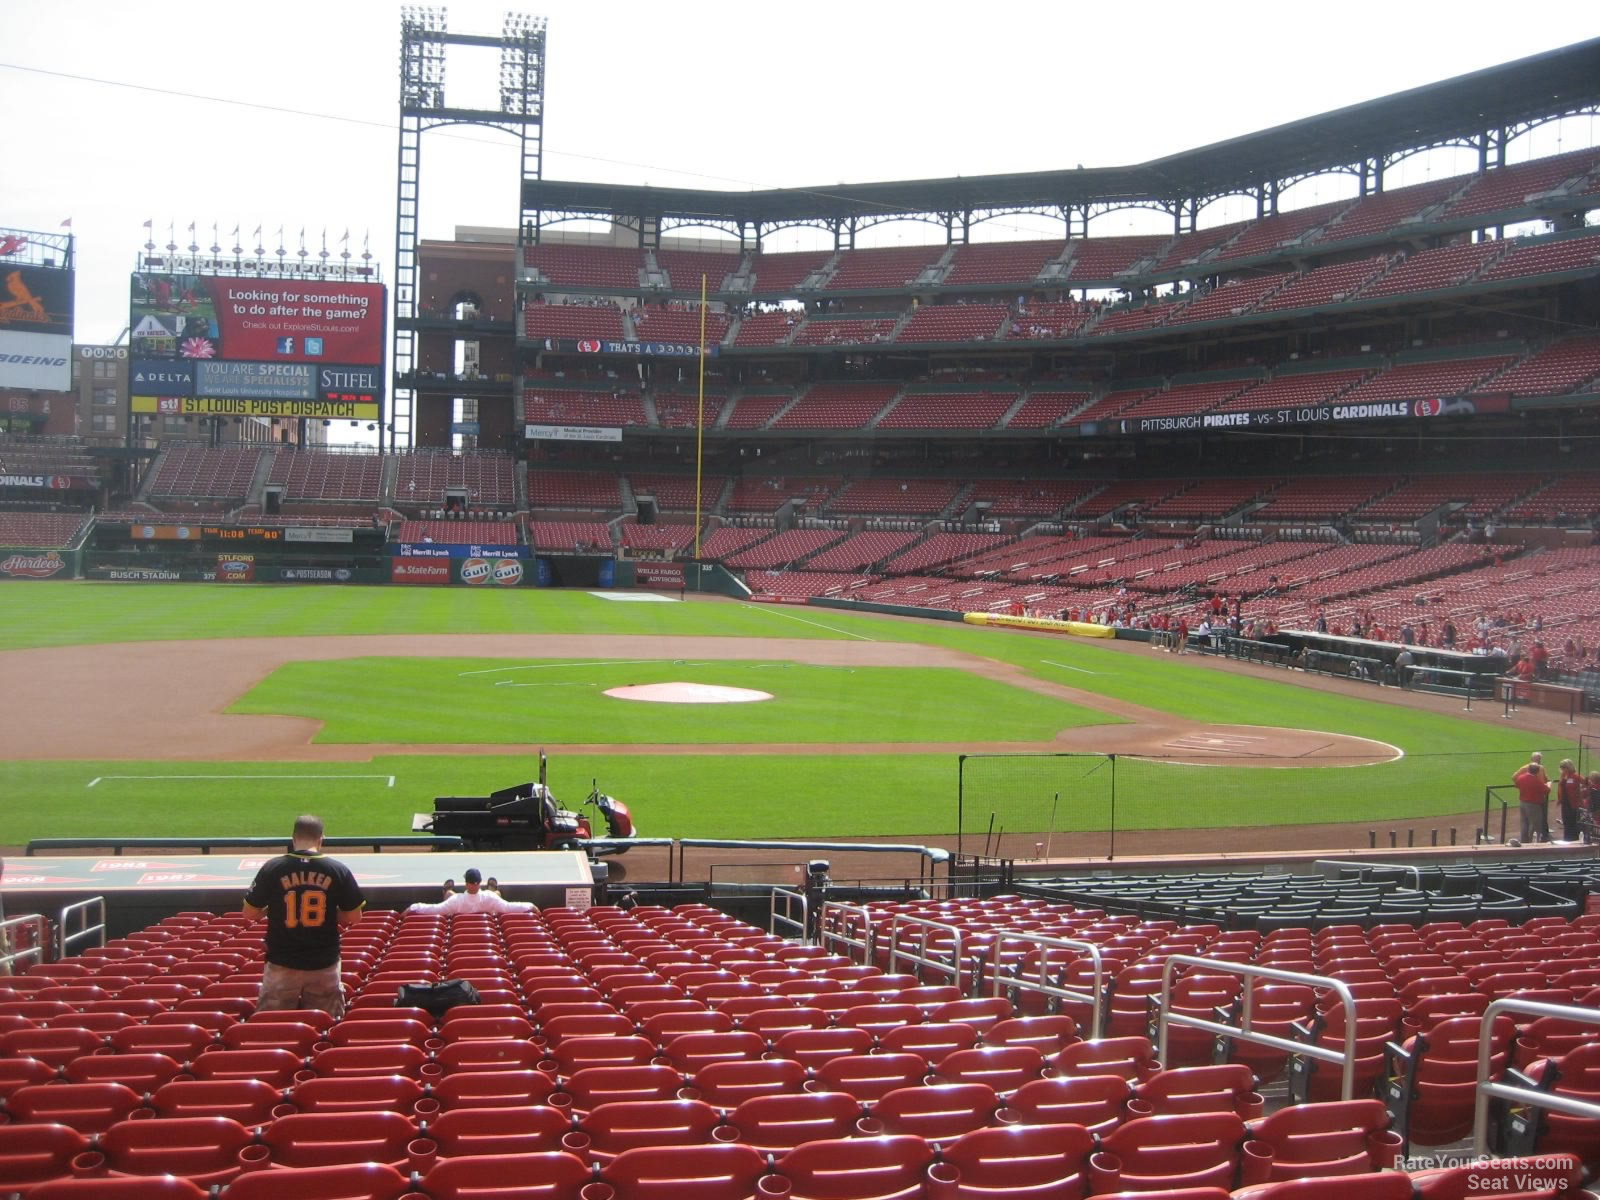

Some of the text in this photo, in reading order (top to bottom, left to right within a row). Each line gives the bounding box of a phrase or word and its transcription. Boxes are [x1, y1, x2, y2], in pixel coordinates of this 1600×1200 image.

[162, 255, 358, 276] WORLD CHAMPIONS
[228, 289, 369, 307] Looking for something
[233, 304, 368, 320] to do after the game?
[242, 321, 268, 329] Check
[270, 322, 282, 330] out
[83, 348, 127, 358] TUMS
[608, 343, 641, 353] THAT'S
[0, 353, 68, 366] BOEING
[203, 363, 310, 377] YOU ARE SPECIAL
[149, 371, 192, 383] DELTA
[203, 374, 310, 386] WE ARE SPECIALISTS
[321, 370, 377, 389] STIFEL
[185, 400, 204, 412] ST.
[207, 401, 246, 413] LOUIS
[251, 402, 355, 416] POST-DISPATCH
[1141, 416, 1201, 431] PITTSBURGH
[1203, 413, 1250, 427] PIRATES
[1277, 410, 1293, 423] ST.
[1296, 408, 1330, 422] LOUIS
[1332, 402, 1408, 419] CARDINALS
[220, 530, 244, 538] 11:08
[110, 571, 180, 580] BUSCH STADIUM
[296, 569, 332, 579] POSTSEASON
[463, 565, 489, 578] Gulf
[495, 566, 520, 579] Gulf
[281, 871, 333, 890] WALKER
[284, 890, 327, 928] 18
